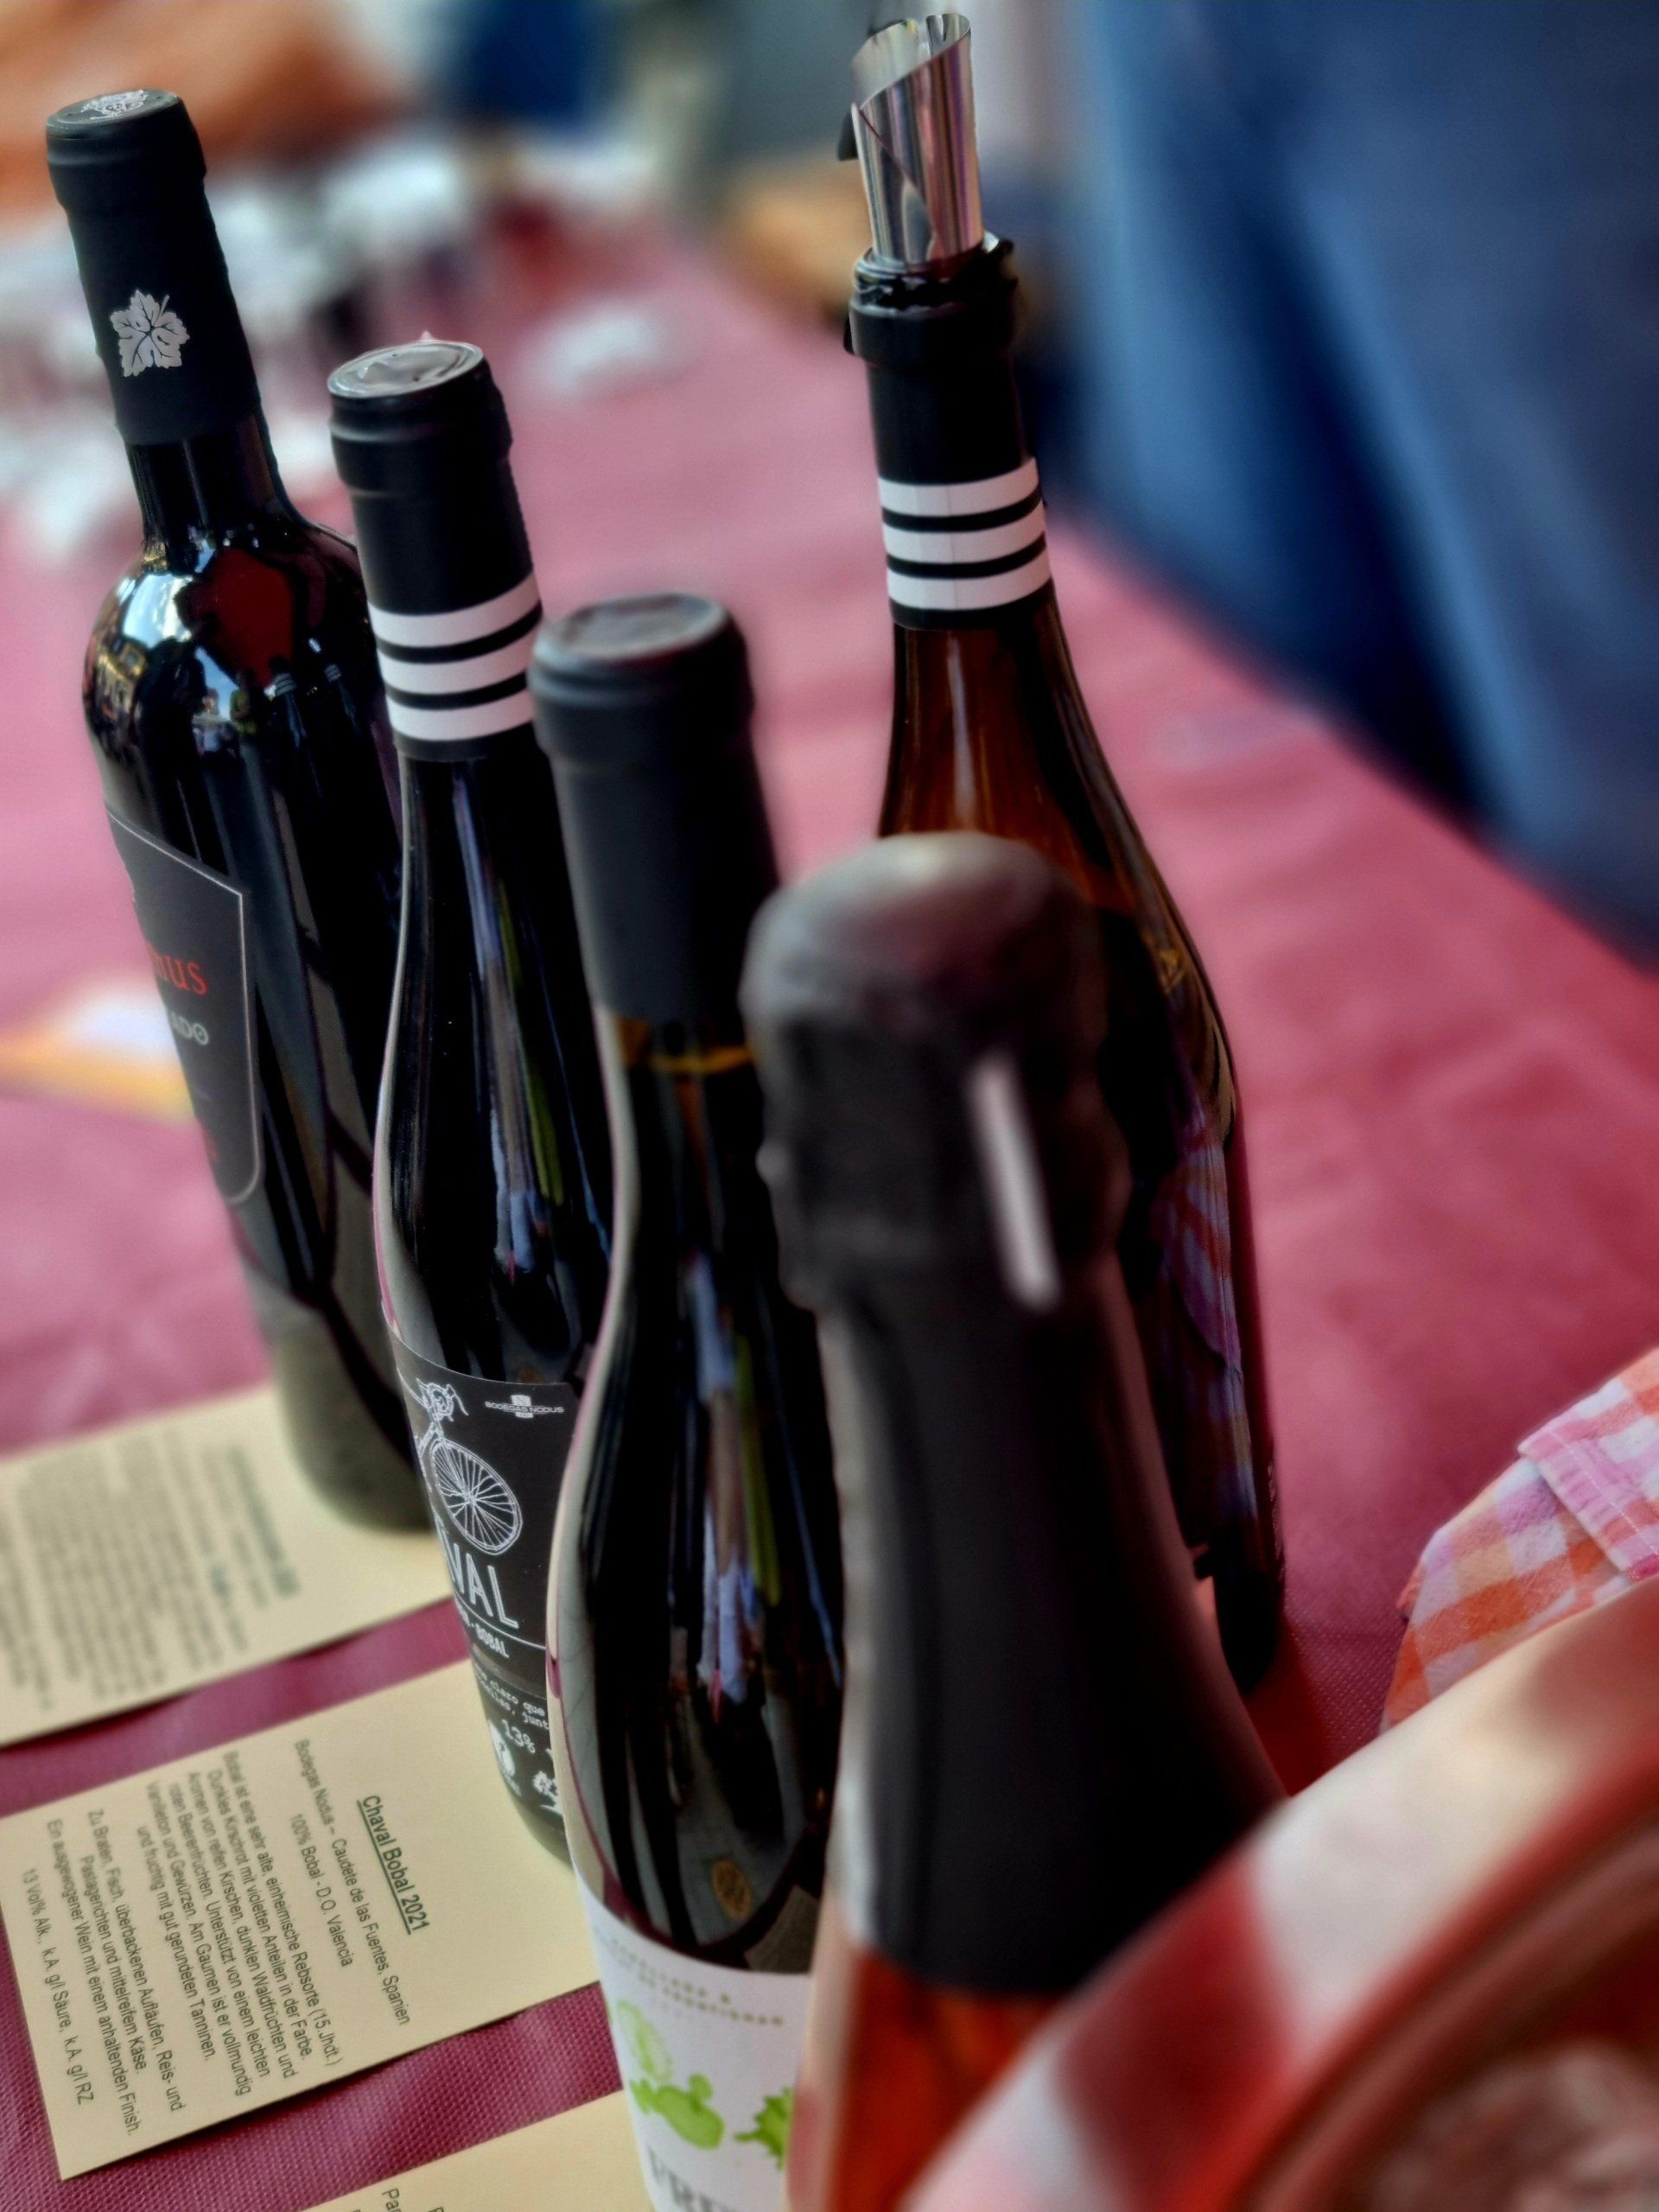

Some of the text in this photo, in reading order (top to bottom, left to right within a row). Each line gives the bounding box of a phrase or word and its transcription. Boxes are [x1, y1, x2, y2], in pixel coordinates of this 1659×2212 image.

[485, 1401, 529, 1413] BODEGAS
[434, 1515, 520, 1629] VAL
[522, 1701, 546, 1717] que
[500, 1718, 537, 1755] 13%
[294, 1738, 321, 1789] Bodegas
[233, 1783, 250, 1798] ist
[312, 1787, 335, 1825] Nodus
[86, 1808, 103, 1827] Zu
[199, 1815, 216, 1837] von
[238, 1799, 256, 1824] eine
[288, 1813, 312, 1846] 100%
[162, 1837, 181, 1859] und
[176, 1812, 213, 1900] Beerenfrüchten.
[207, 1838, 226, 1871] reifen
[247, 1825, 267, 1850] sehr
[21, 1867, 38, 1884] 13
[300, 1846, 324, 1879] Bobal
[331, 1837, 359, 1886] Caudete
[359, 1793, 432, 1932] Chaval Bobal 2021
[24, 1883, 46, 1916] Vol%
[168, 1859, 196, 1921] Gewürzen.
[217, 1870, 244, 1926] Kirschen,
[315, 1886, 336, 1915] D.O.
[349, 1885, 365, 1903] de
[188, 1920, 205, 1942] Am
[206, 1769, 314, 2060] Dunkles Kirschrot mit violetten Anteilen in der Farbe.
[264, 1877, 302, 1951] einheimische
[355, 1902, 372, 1923] las
[113, 1903, 147, 1986] überbackenen
[136, 1825, 215, 2061] und fruchtig mit gut gerundeten Tanninen.
[204, 1900, 238, 1964] Unterstützt
[234, 1923, 260, 1972] dunklen
[325, 1914, 354, 1967] Valencia
[363, 1921, 391, 1975] Fuentes,
[41, 1946, 60, 1972] k.A.
[46, 1818, 143, 2135] Ein ausgewogener Wein mit einem anhaltenden Finish.
[78, 1854, 147, 2074] Pastagerichten und mittelreifem Käse.
[194, 1942, 220, 1995] Gaumen
[225, 1965, 242, 1988] von
[43, 1974, 65, 1990] g/l
[291, 1951, 321, 2007] Rebsorte
[51, 1989, 71, 2034] Säure,
[211, 1995, 229, 2012] ist
[232, 1989, 255, 2028] einem
[250, 1971, 287, 2053] Waldfrüchten
[382, 1974, 411, 2024] Spanien
[137, 1986, 164, 2051] Aufläufen,
[215, 2012, 231, 2029] er
[307, 2006, 344, 2067] (15.Jhdt.)
[62, 2035, 82, 2063] k.A.
[155, 2049, 175, 2086] Reis-
[220, 2028, 253, 2097] vollmundig
[245, 2027, 270, 2077] leichten
[276, 2053, 299, 2079] und
[66, 2063, 88, 2082] g/l
[73, 2081, 94, 2105] RZ
[164, 2086, 187, 2112] und
